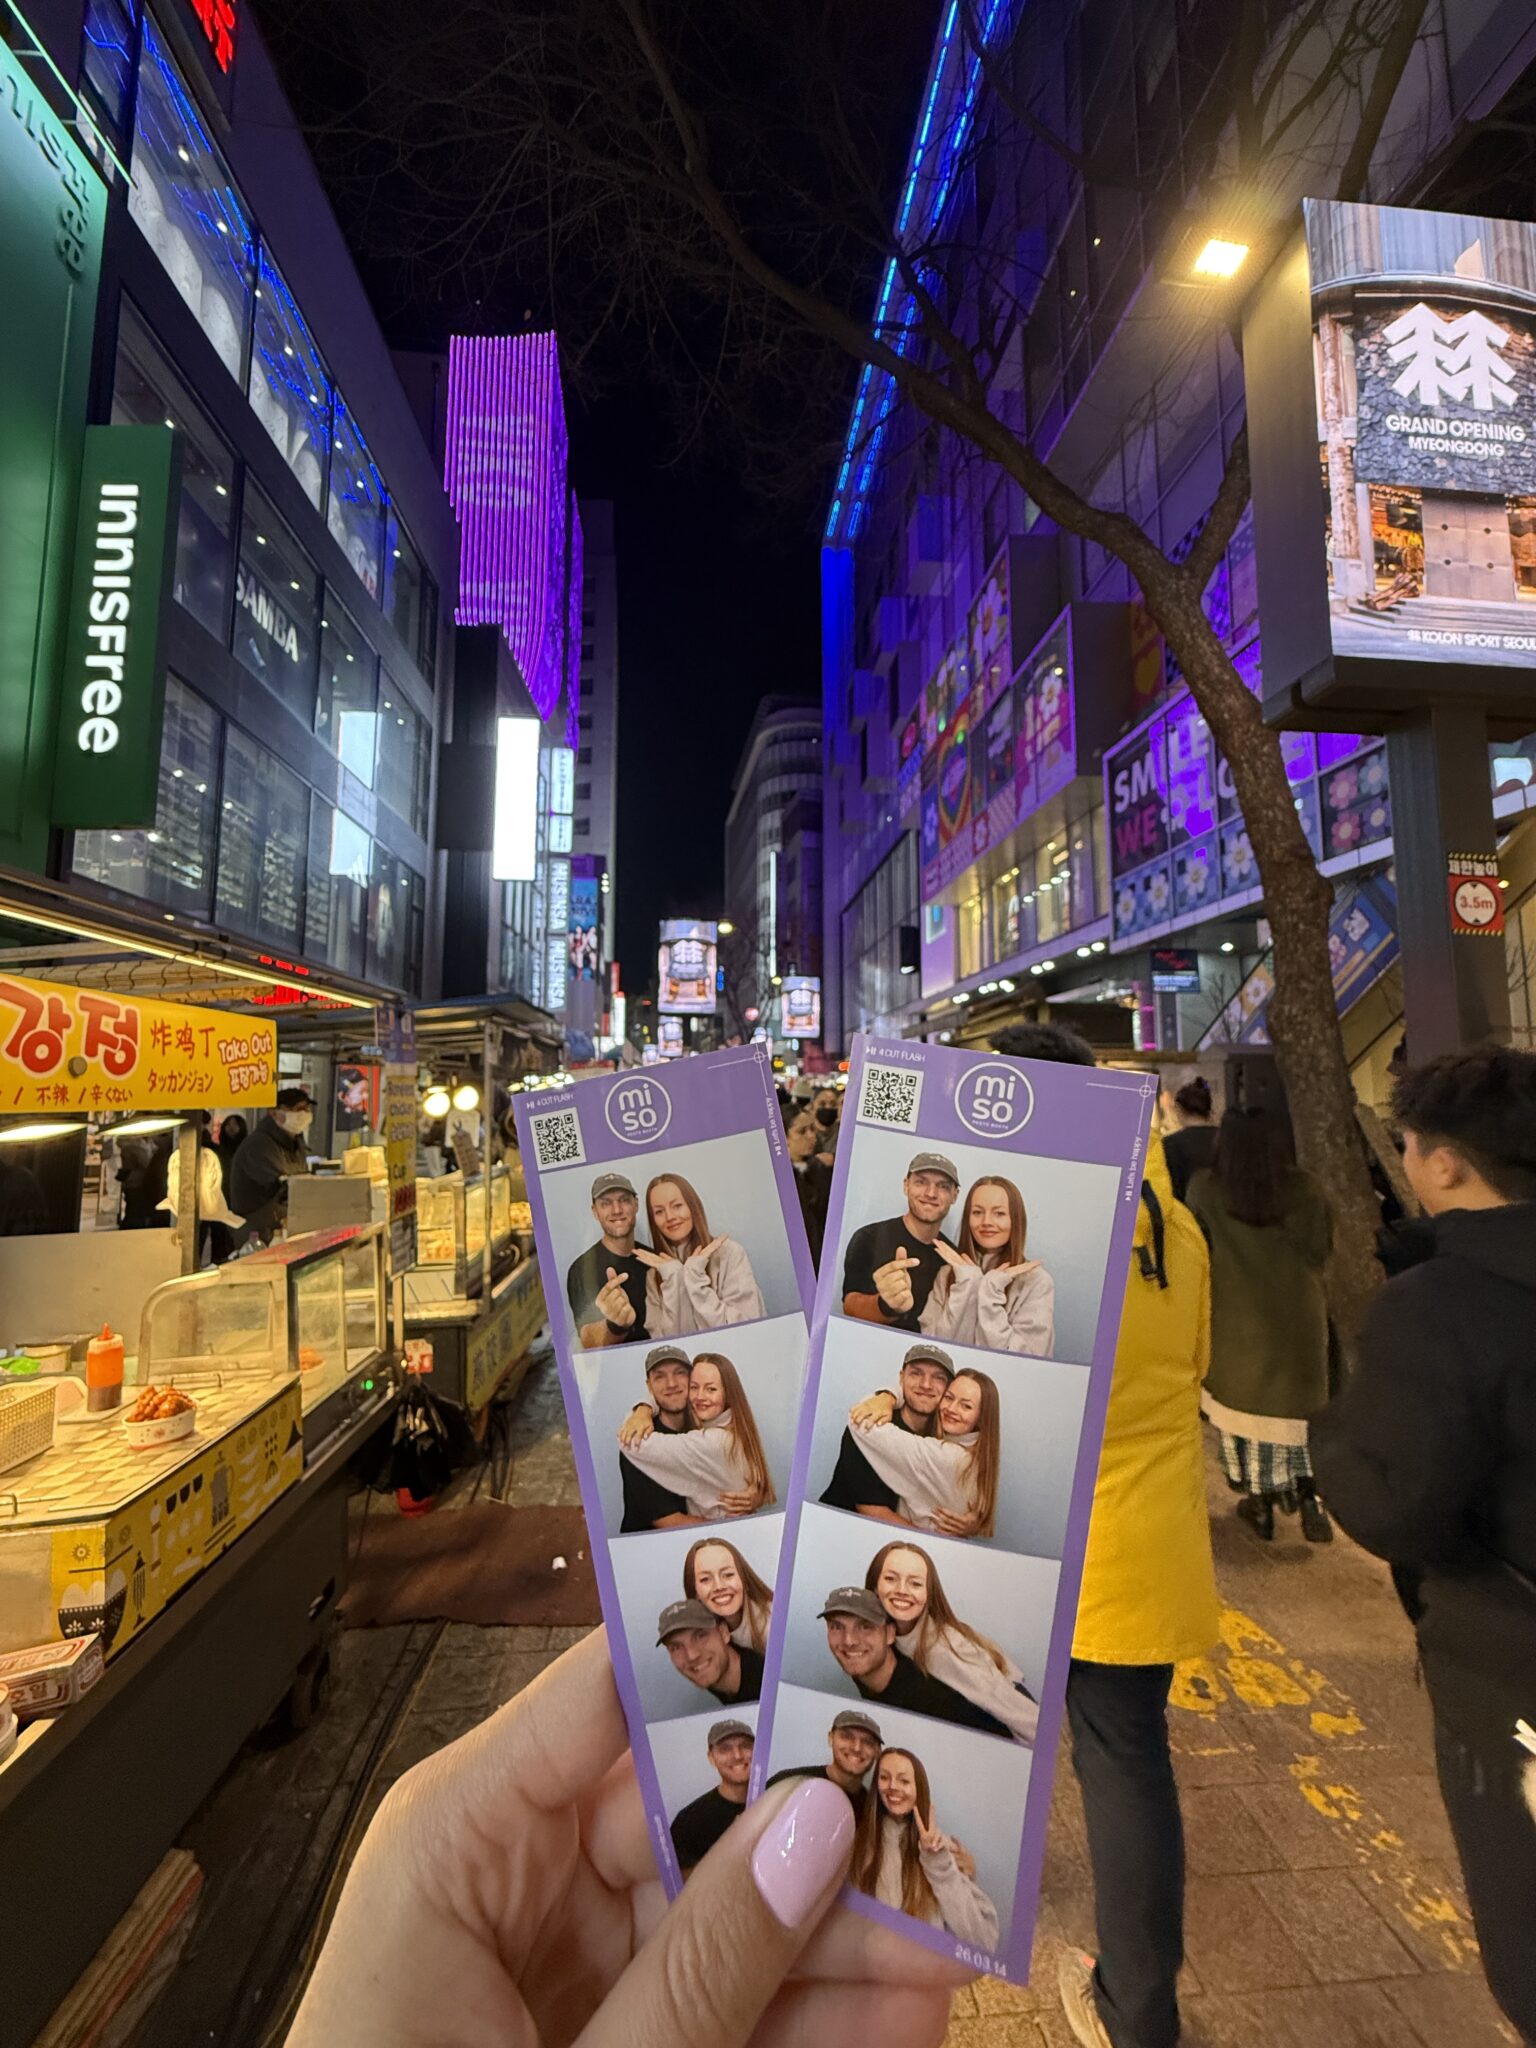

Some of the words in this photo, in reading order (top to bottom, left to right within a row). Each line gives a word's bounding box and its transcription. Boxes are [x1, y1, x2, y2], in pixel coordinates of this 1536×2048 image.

[1385, 413, 1448, 435] GRAND
[1448, 419, 1527, 442] OPENING
[1408, 435, 1505, 457] MYEONGDONG
[236, 568, 299, 662] SAMBA
[1421, 630, 1463, 645] KOLON
[1463, 633, 1501, 649] SPORT
[1115, 803, 1159, 858] WE
[549, 862, 568, 930] MUSINSA
[1459, 895, 1493, 909] 3.5m
[548, 939, 567, 1009] MUSINSA
[150, 1018, 216, 1059] 炸鸡丁
[217, 1038, 250, 1065] Take
[250, 1032, 274, 1060] Out
[901, 1050, 927, 1063] FLASH
[147, 1069, 215, 1094] タッカンジョン
[227, 1057, 271, 1096] 포장가능
[974, 1074, 1016, 1101] mi
[36, 1083, 69, 1106] 不辣
[91, 1083, 133, 1106] 辛くない
[618, 1082, 653, 1111] mi
[622, 1107, 658, 1132] so
[971, 1100, 1014, 1124] so
